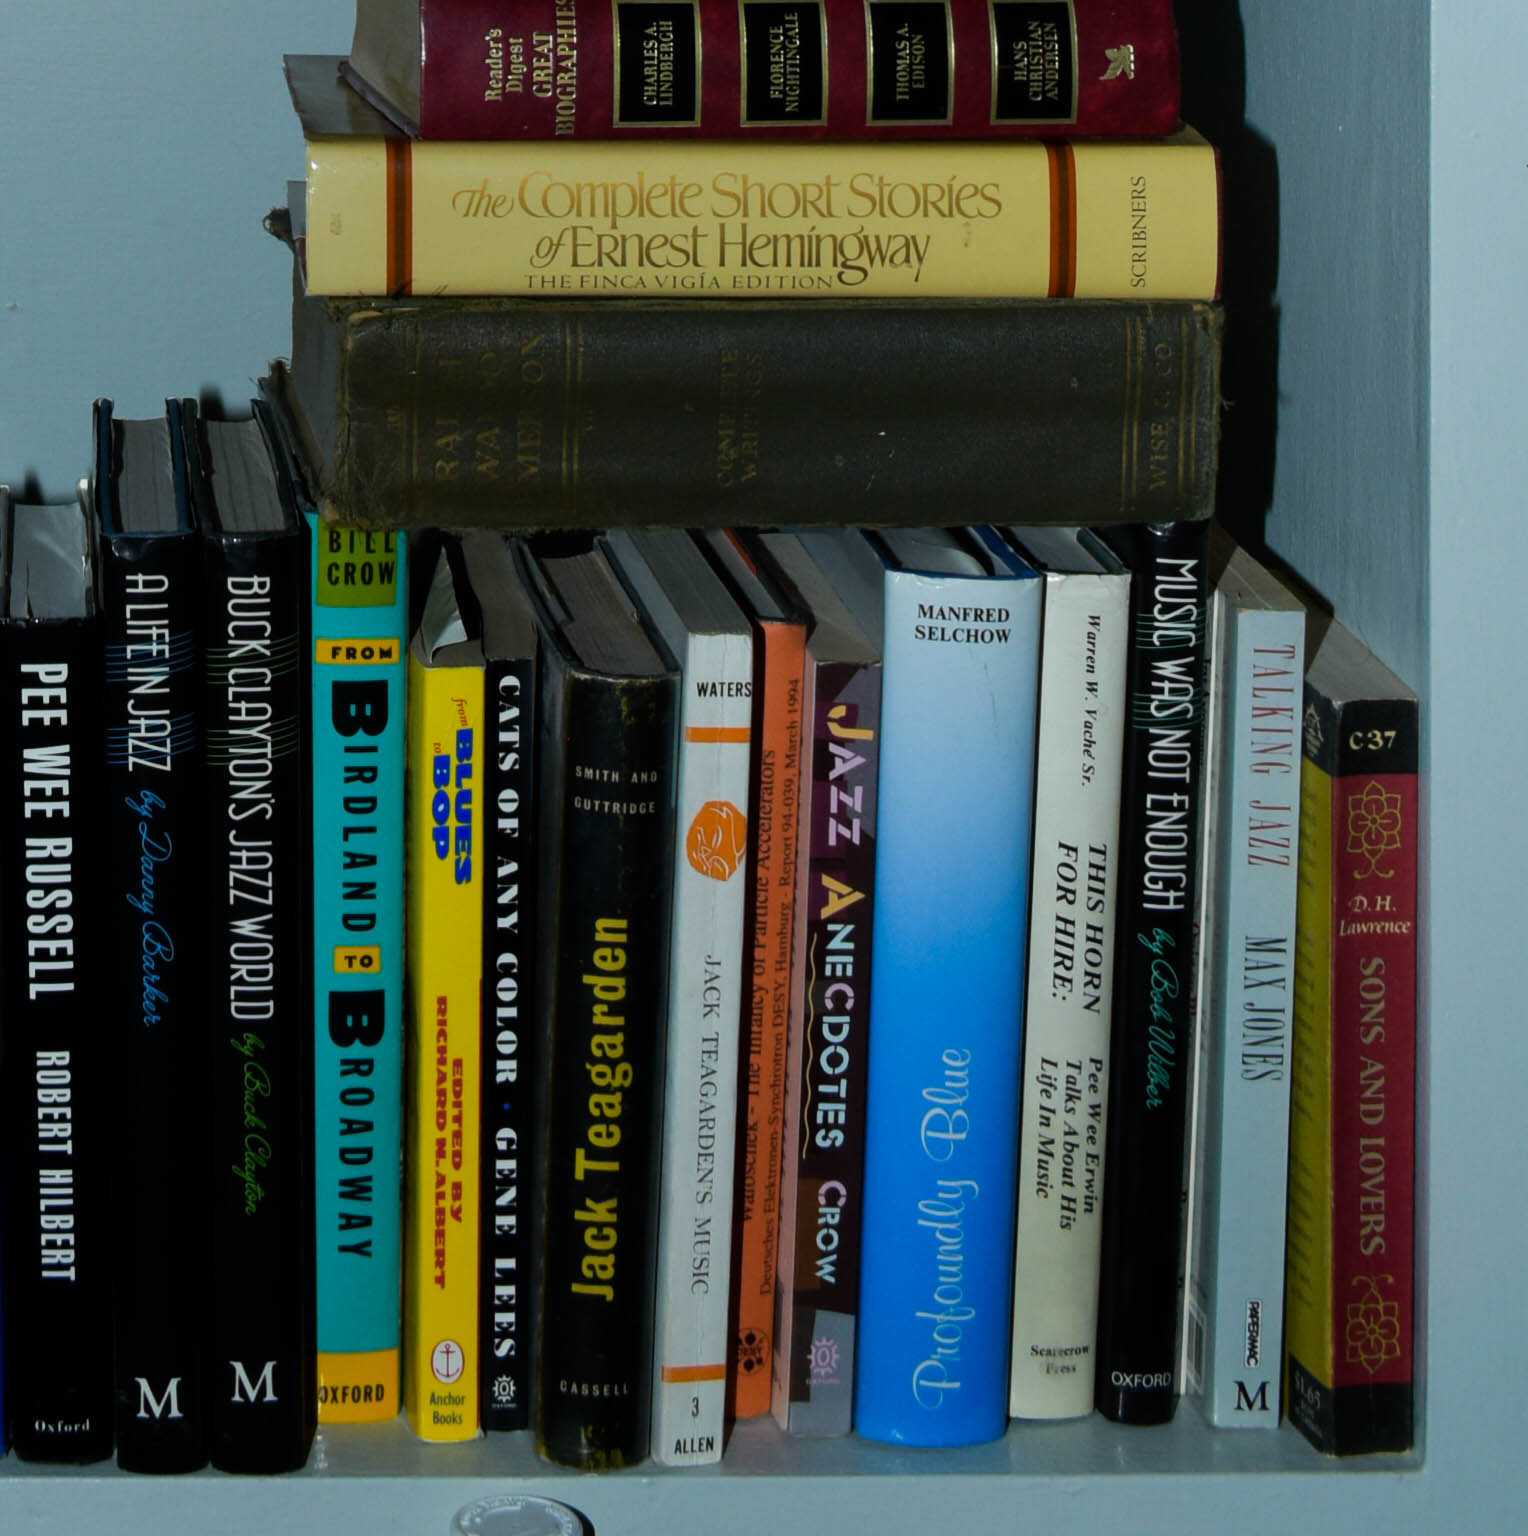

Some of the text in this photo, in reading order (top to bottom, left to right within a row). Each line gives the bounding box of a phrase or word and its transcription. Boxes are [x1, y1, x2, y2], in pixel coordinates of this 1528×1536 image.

[532, 31, 553, 98] GREAT
[697, 681, 752, 698] WATERS
[914, 625, 1012, 644] SELCHOW
[917, 603, 1010, 624] MANFRED
[21, 663, 75, 999] PEE WEE RUSSELL
[332, 680, 389, 934] BIRDLAND
[1142, 558, 1199, 911] MUSIC WAS NOT ENOUGH
[1247, 644, 1297, 867] TALKING JAZZ
[36, 1050, 77, 1283] ROBERT HILBERT
[328, 989, 385, 1258] BROADWAY
